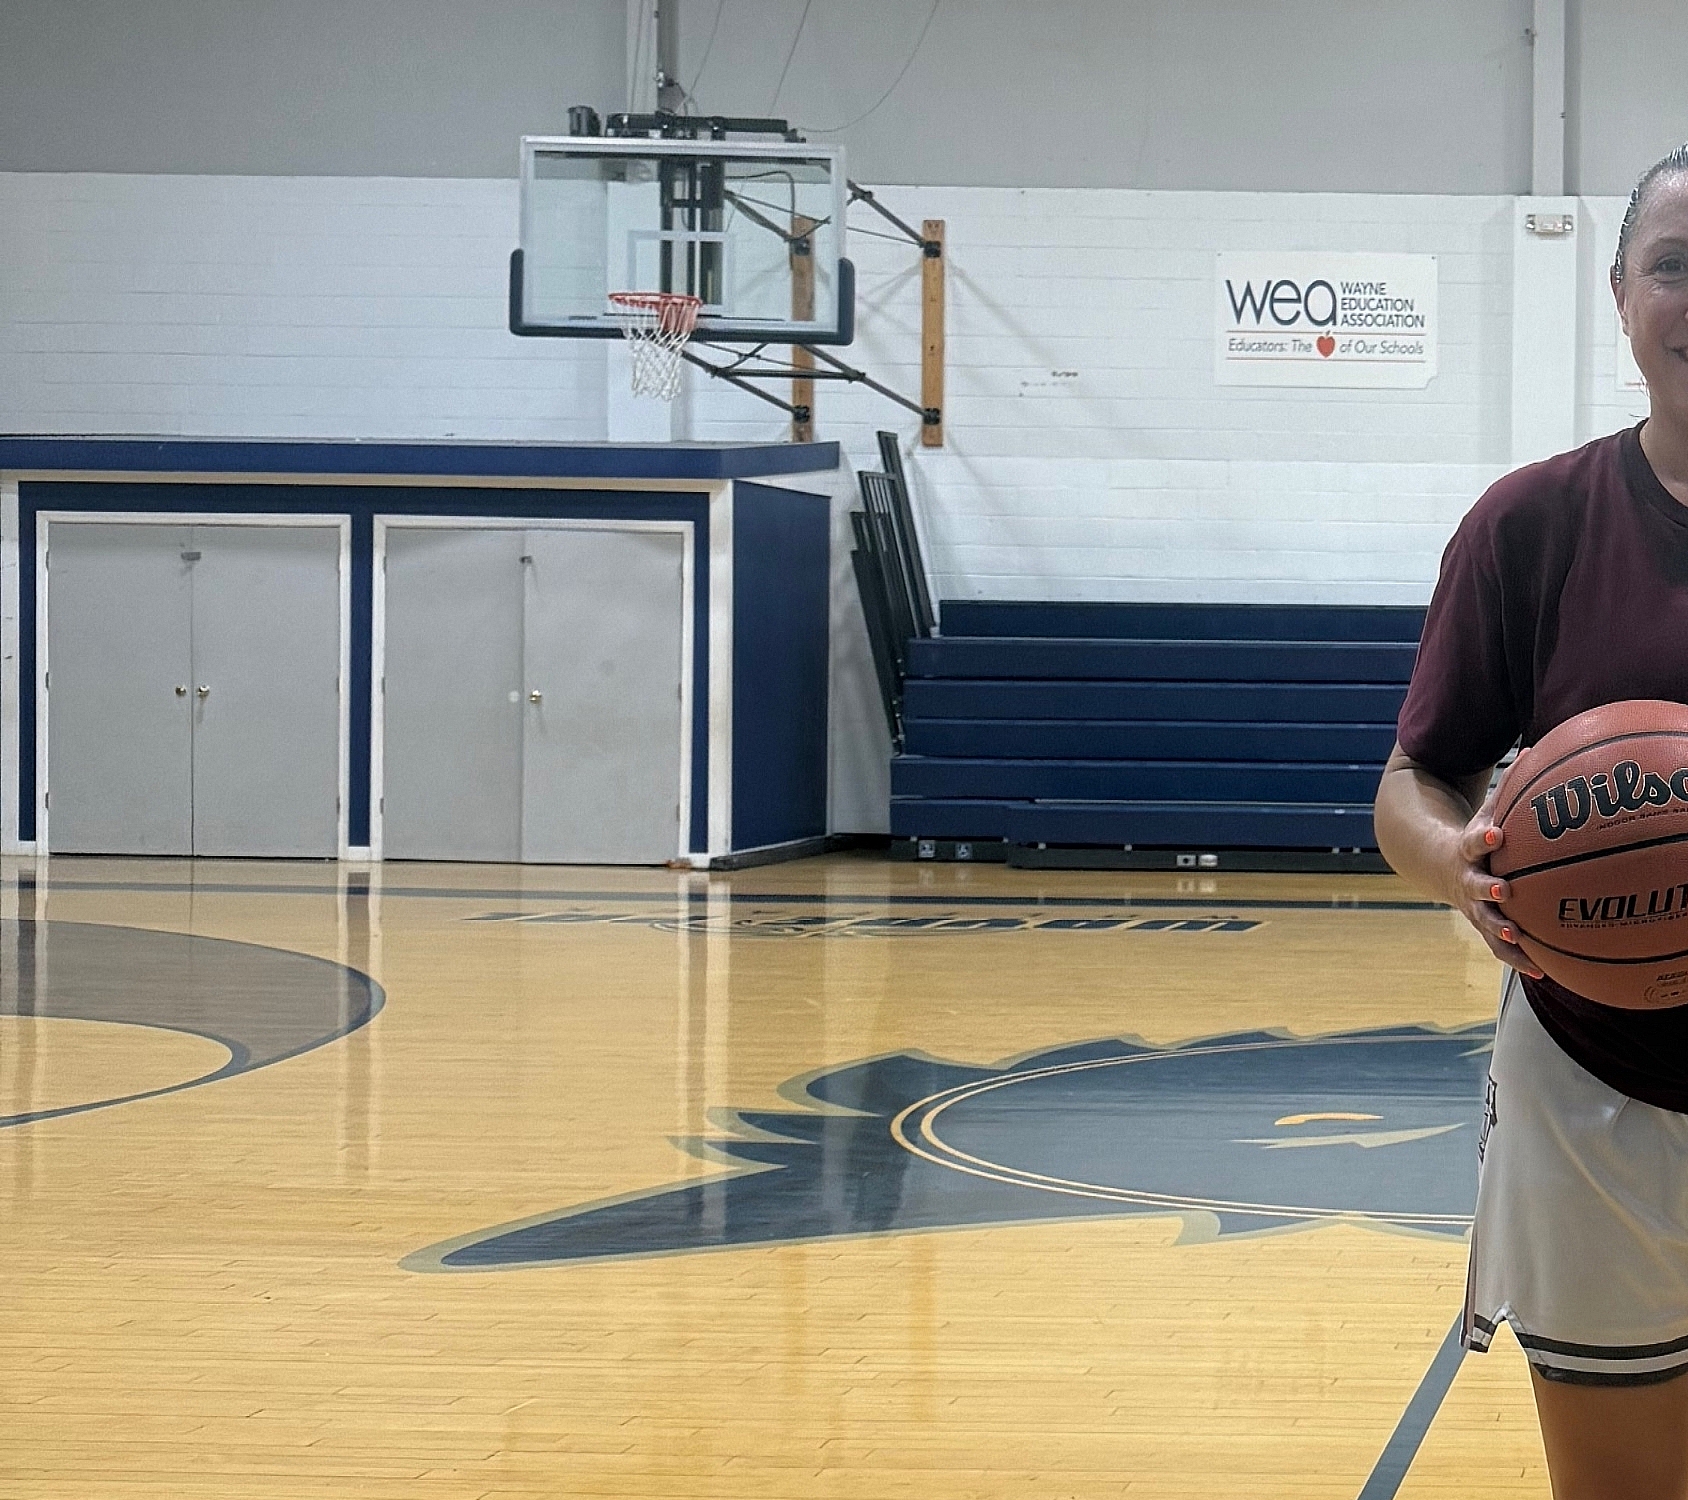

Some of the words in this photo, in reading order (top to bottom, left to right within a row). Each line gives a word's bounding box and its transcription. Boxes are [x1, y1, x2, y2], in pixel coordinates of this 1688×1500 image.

[1341, 282, 1387, 296] WAYNE
[1341, 297, 1414, 312] EDUCATION
[1341, 313, 1425, 328] ASSOCIATION
[1292, 339, 1312, 353] The
[1340, 339, 1353, 354] of
[1354, 340, 1377, 354] Our
[1380, 340, 1424, 355] Schools
